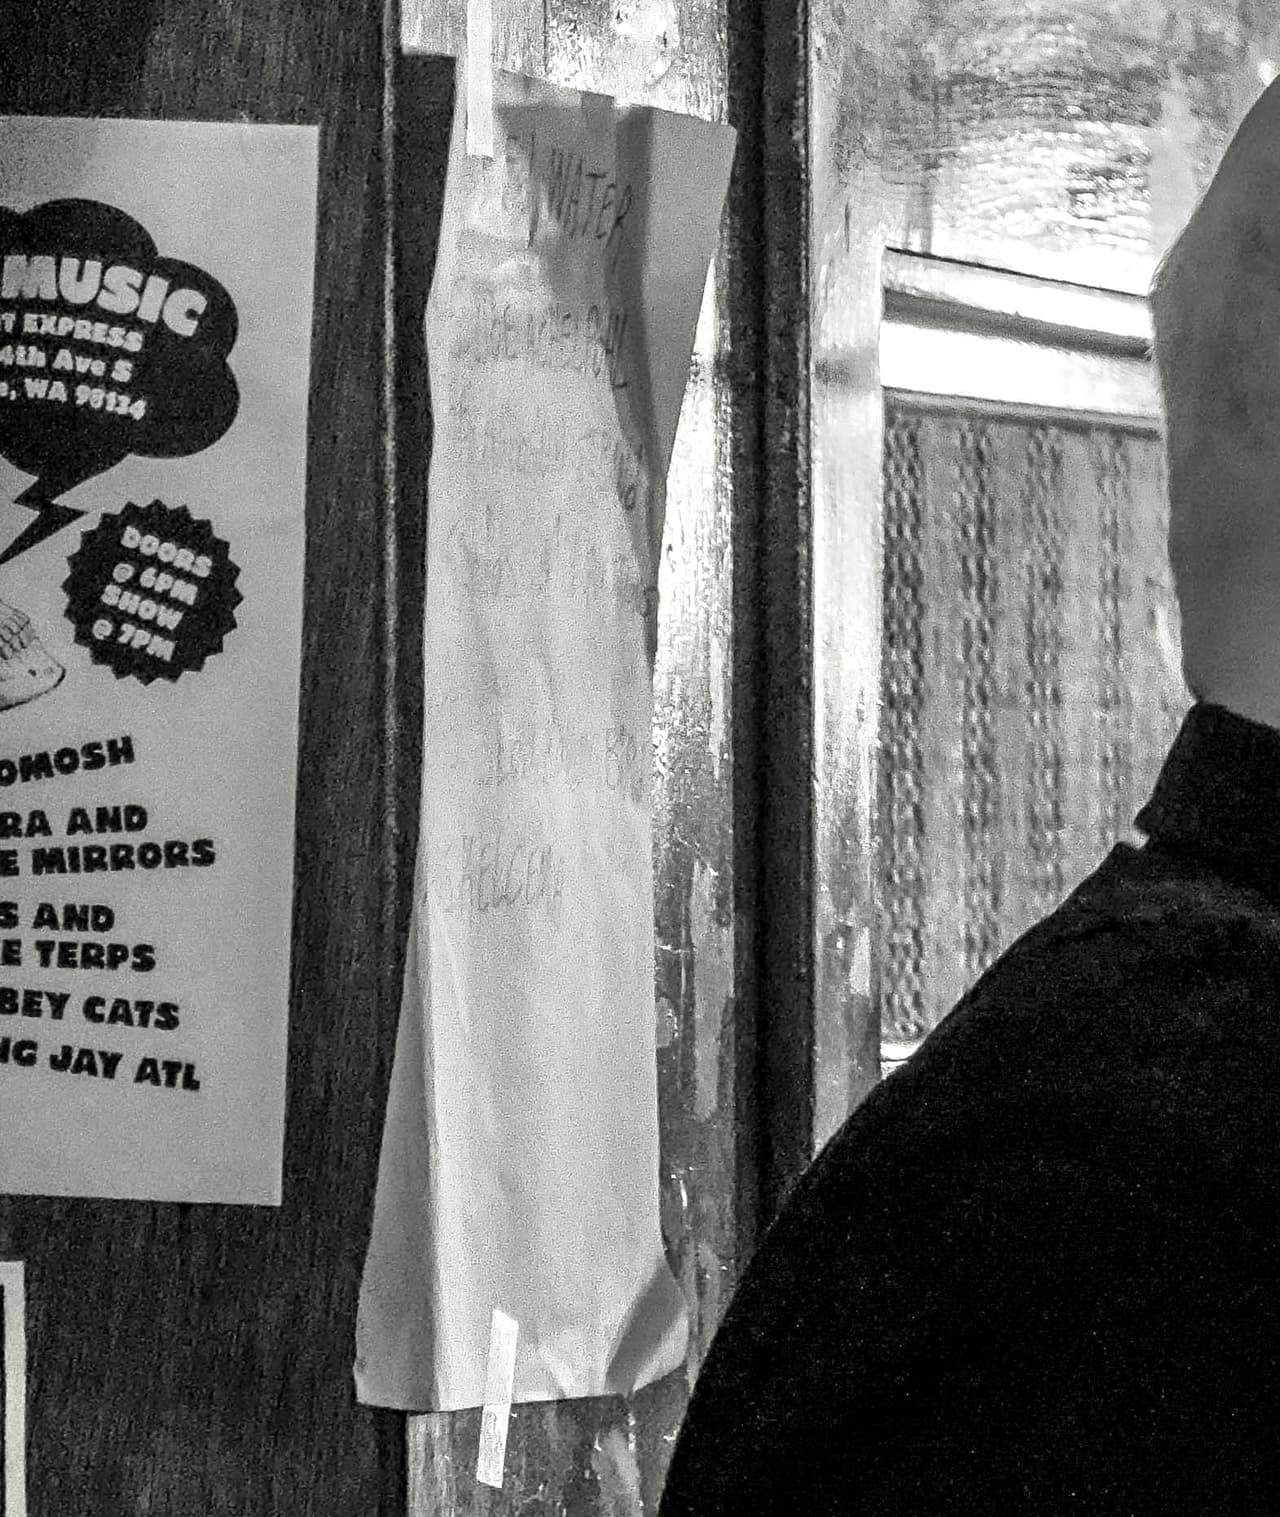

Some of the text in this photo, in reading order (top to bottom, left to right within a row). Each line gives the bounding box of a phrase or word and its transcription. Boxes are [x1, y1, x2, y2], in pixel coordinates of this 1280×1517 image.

[1, 254, 208, 337] MUSIC
[0, 312, 143, 352] T EXPRESS
[52, 348, 106, 376] Ave
[110, 358, 133, 382] S
[24, 377, 67, 403] WA
[120, 525, 213, 578] DOORS
[112, 562, 198, 606] @ 6PM
[100, 584, 184, 630] SHOW
[92, 618, 176, 662] @ 7PM
[66, 804, 148, 836] AND
[31, 838, 216, 876] MIRRORS
[31, 902, 115, 933] AND
[35, 939, 156, 973] TERPS
[82, 995, 181, 1031] CATS
[50, 1045, 123, 1080] JAY
[133, 1057, 201, 1091] ATL
